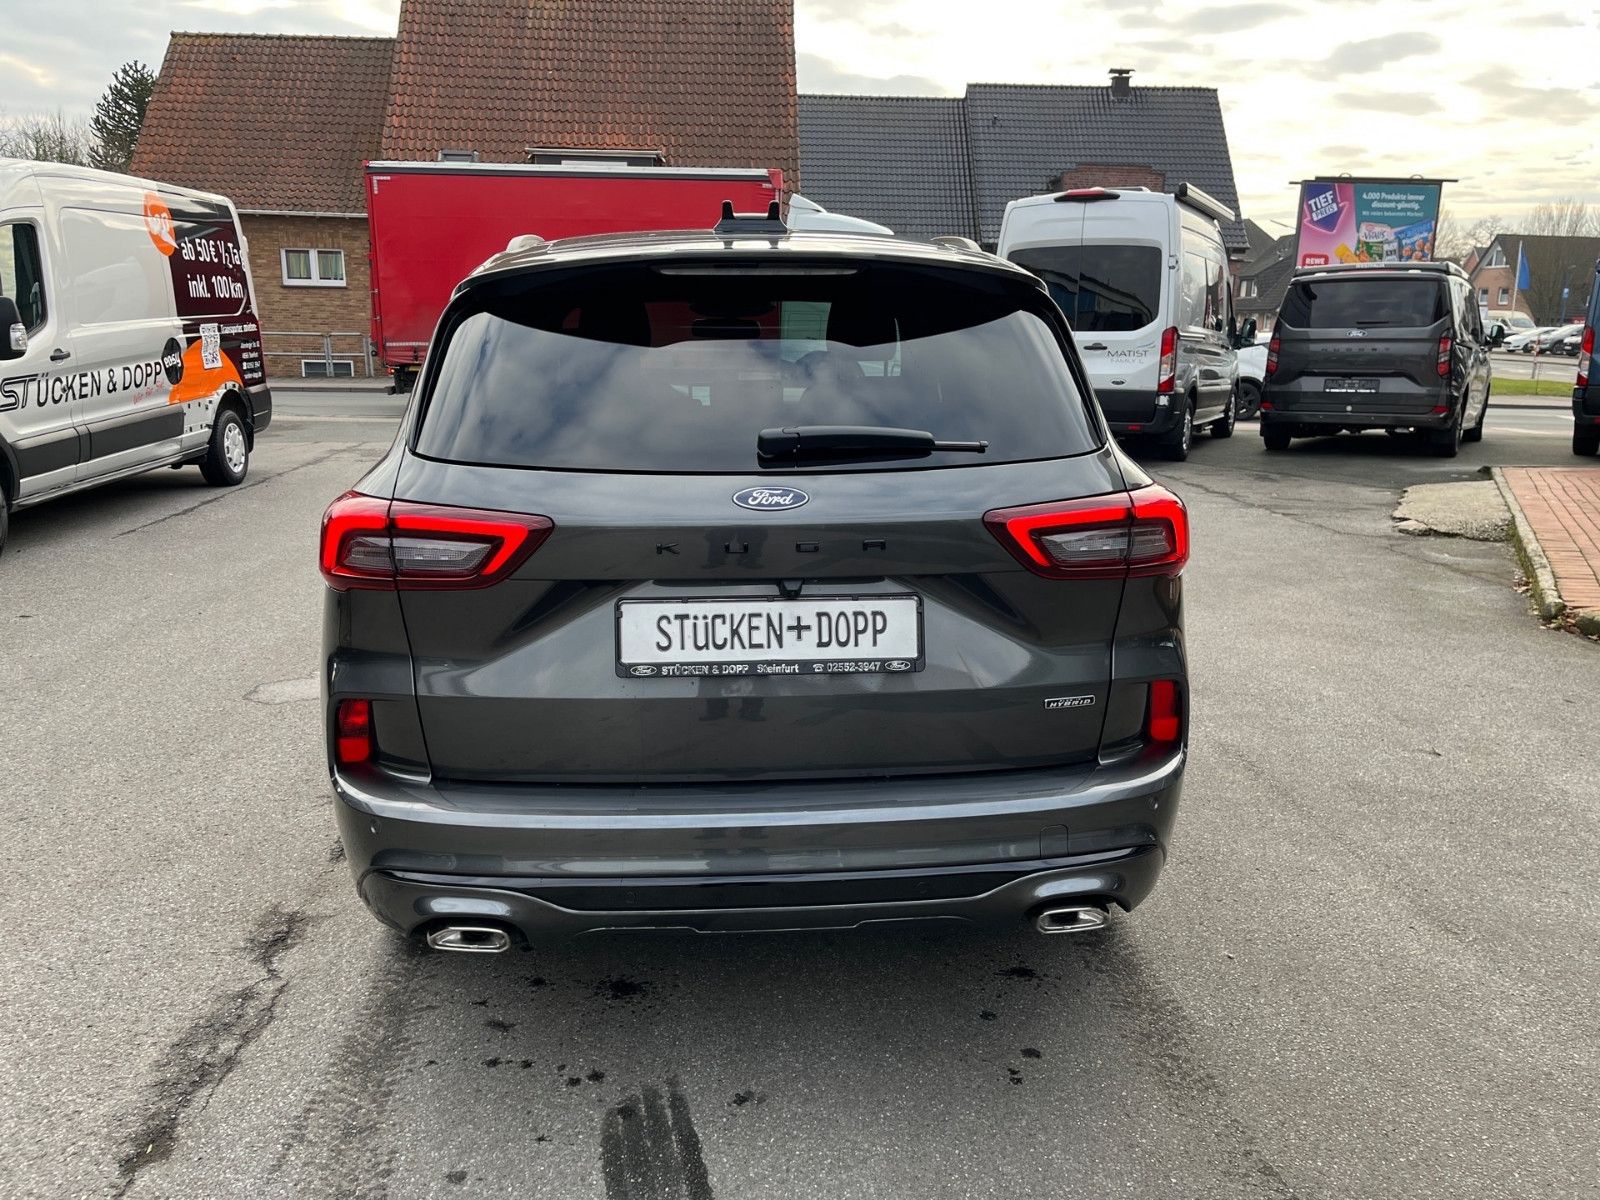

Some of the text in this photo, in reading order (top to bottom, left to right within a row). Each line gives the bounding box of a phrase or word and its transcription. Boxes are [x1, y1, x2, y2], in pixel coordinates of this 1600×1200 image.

[1308, 190, 1334, 211] TIEF
[1314, 202, 1336, 219] PREIS
[181, 237, 195, 261] ab
[1305, 257, 1325, 265] REWE
[187, 274, 210, 298] inkl.
[163, 352, 182, 368] easy
[1107, 350, 1149, 358] MATIST
[0, 370, 101, 412] STÜCKEN
[107, 368, 118, 393] &
[122, 361, 162, 390] DOPP
[747, 489, 794, 505] Ford
[661, 664, 709, 676] STÜCKEN
[712, 665, 720, 675] &
[722, 664, 749, 675] DOPP
[757, 663, 799, 675] Steinfurt
[826, 661, 881, 673] 02552-3947
[1050, 698, 1091, 708] HYBRID
